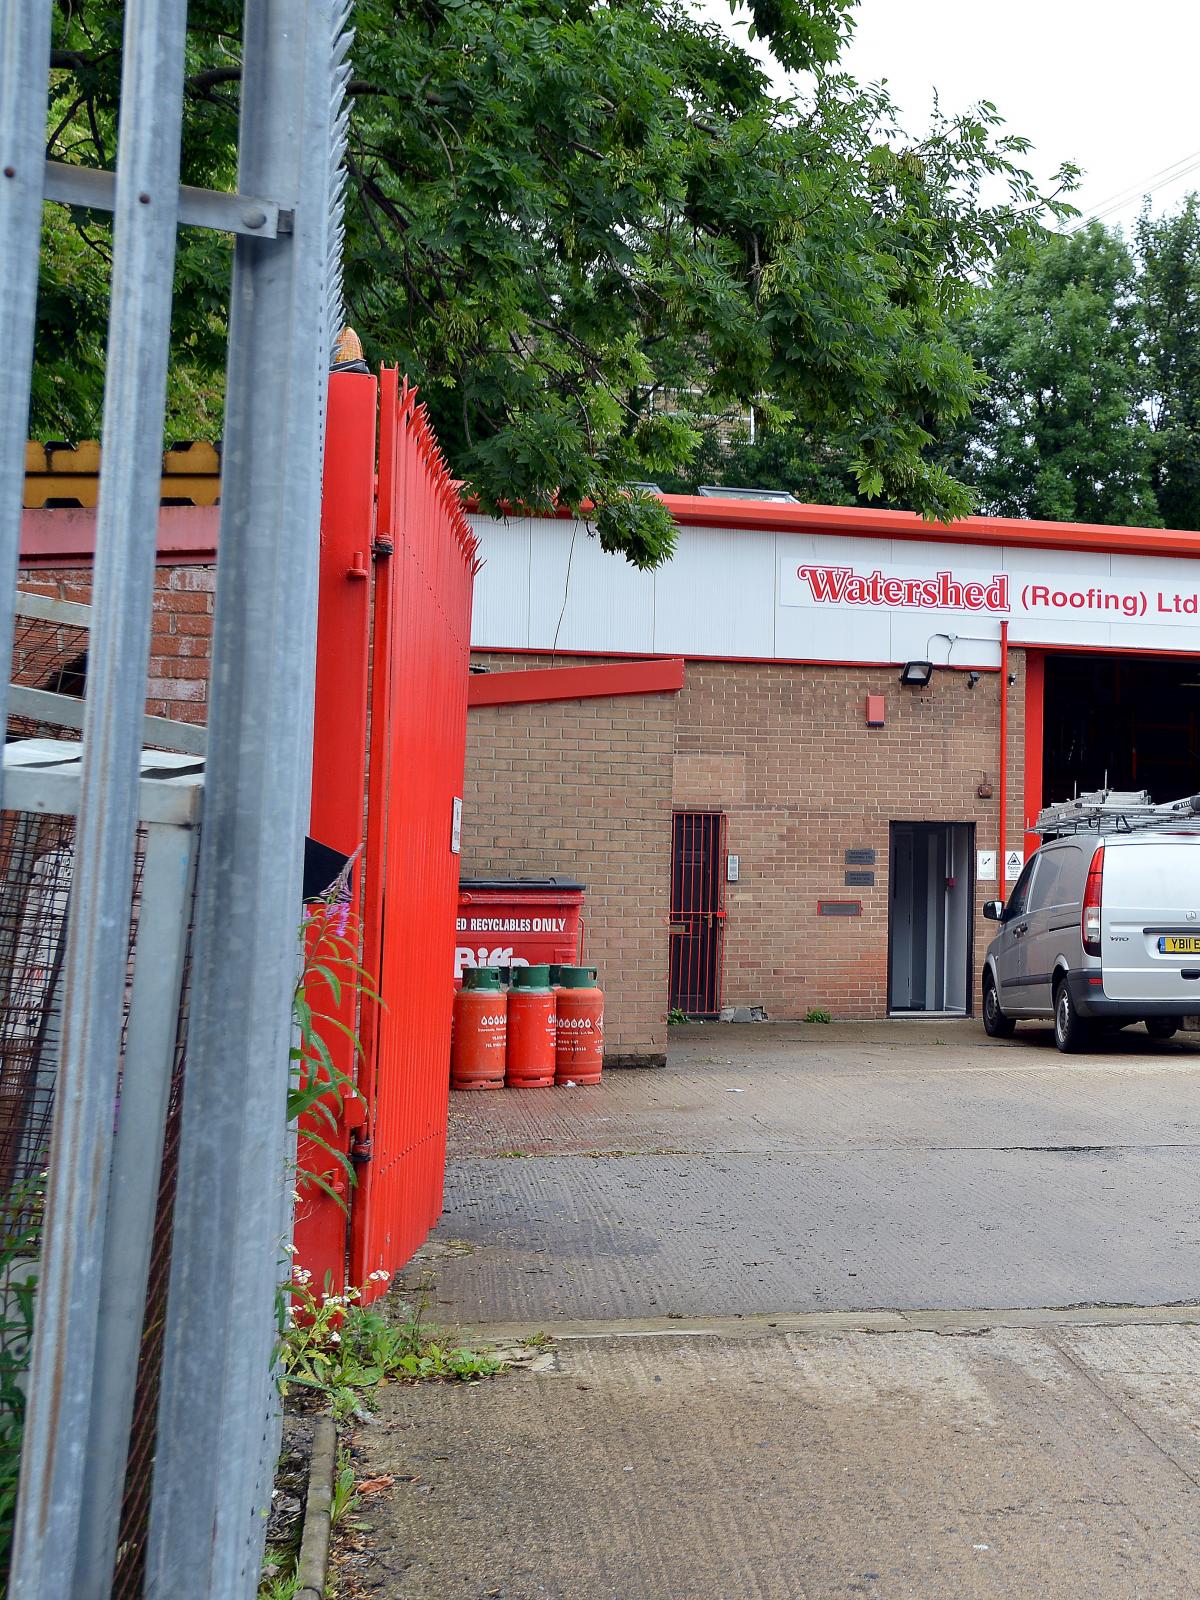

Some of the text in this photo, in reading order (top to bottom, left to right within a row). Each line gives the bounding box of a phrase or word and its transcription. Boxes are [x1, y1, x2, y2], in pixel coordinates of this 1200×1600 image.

[798, 565, 1199, 616] Watershed (Roofing) Ltd
[470, 919, 531, 932] RECYCLABLES
[532, 918, 566, 932] ONLY
[1171, 939, 1191, 950] YB11
